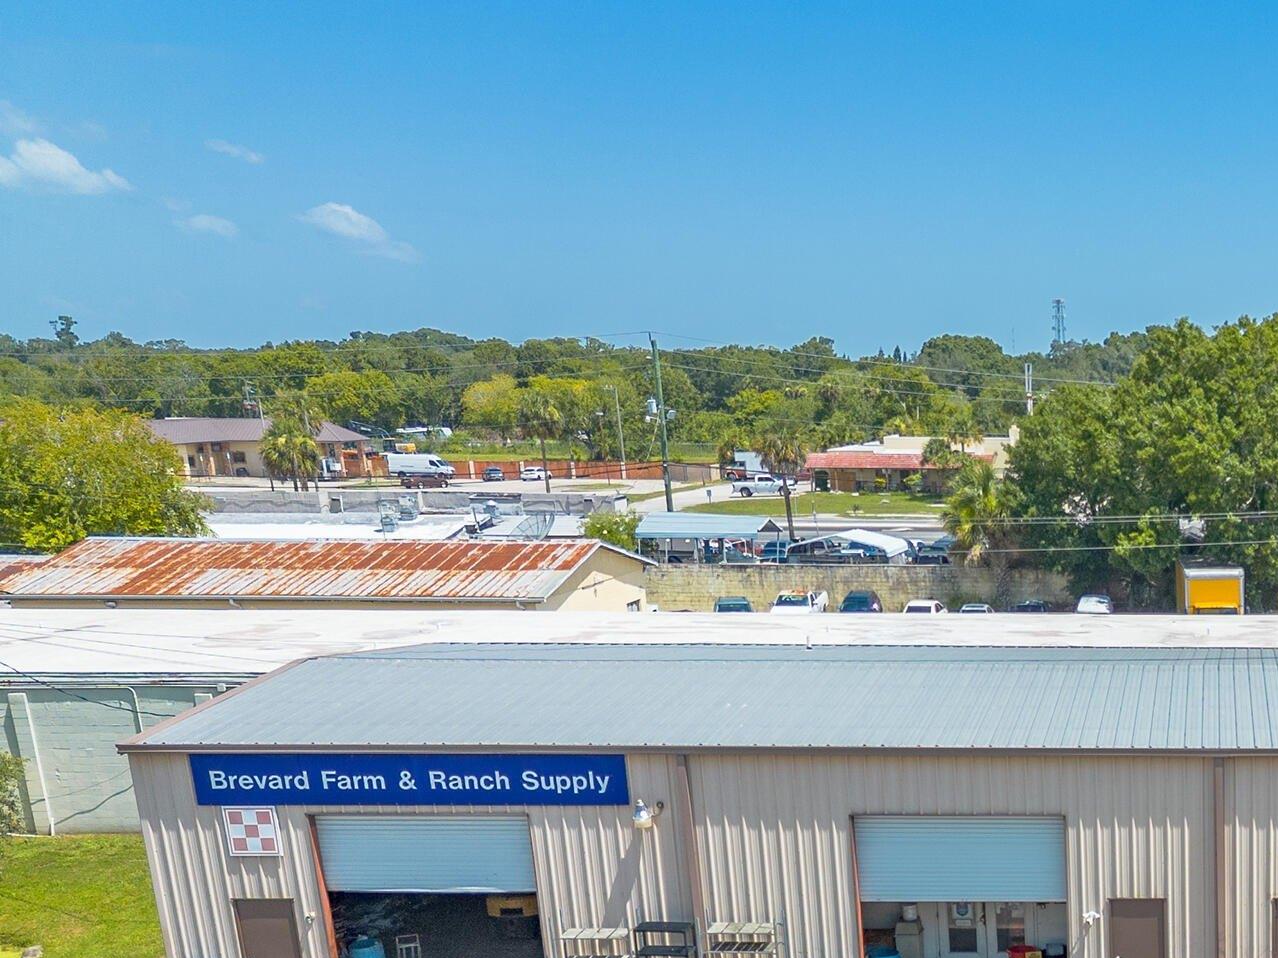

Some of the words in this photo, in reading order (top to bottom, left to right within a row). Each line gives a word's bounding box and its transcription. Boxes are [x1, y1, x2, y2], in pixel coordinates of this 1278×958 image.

[208, 770, 310, 790] Brevard
[321, 770, 387, 790] Farm
[398, 770, 418, 790] &
[428, 770, 511, 790] Ranch
[521, 770, 610, 794] Supply
